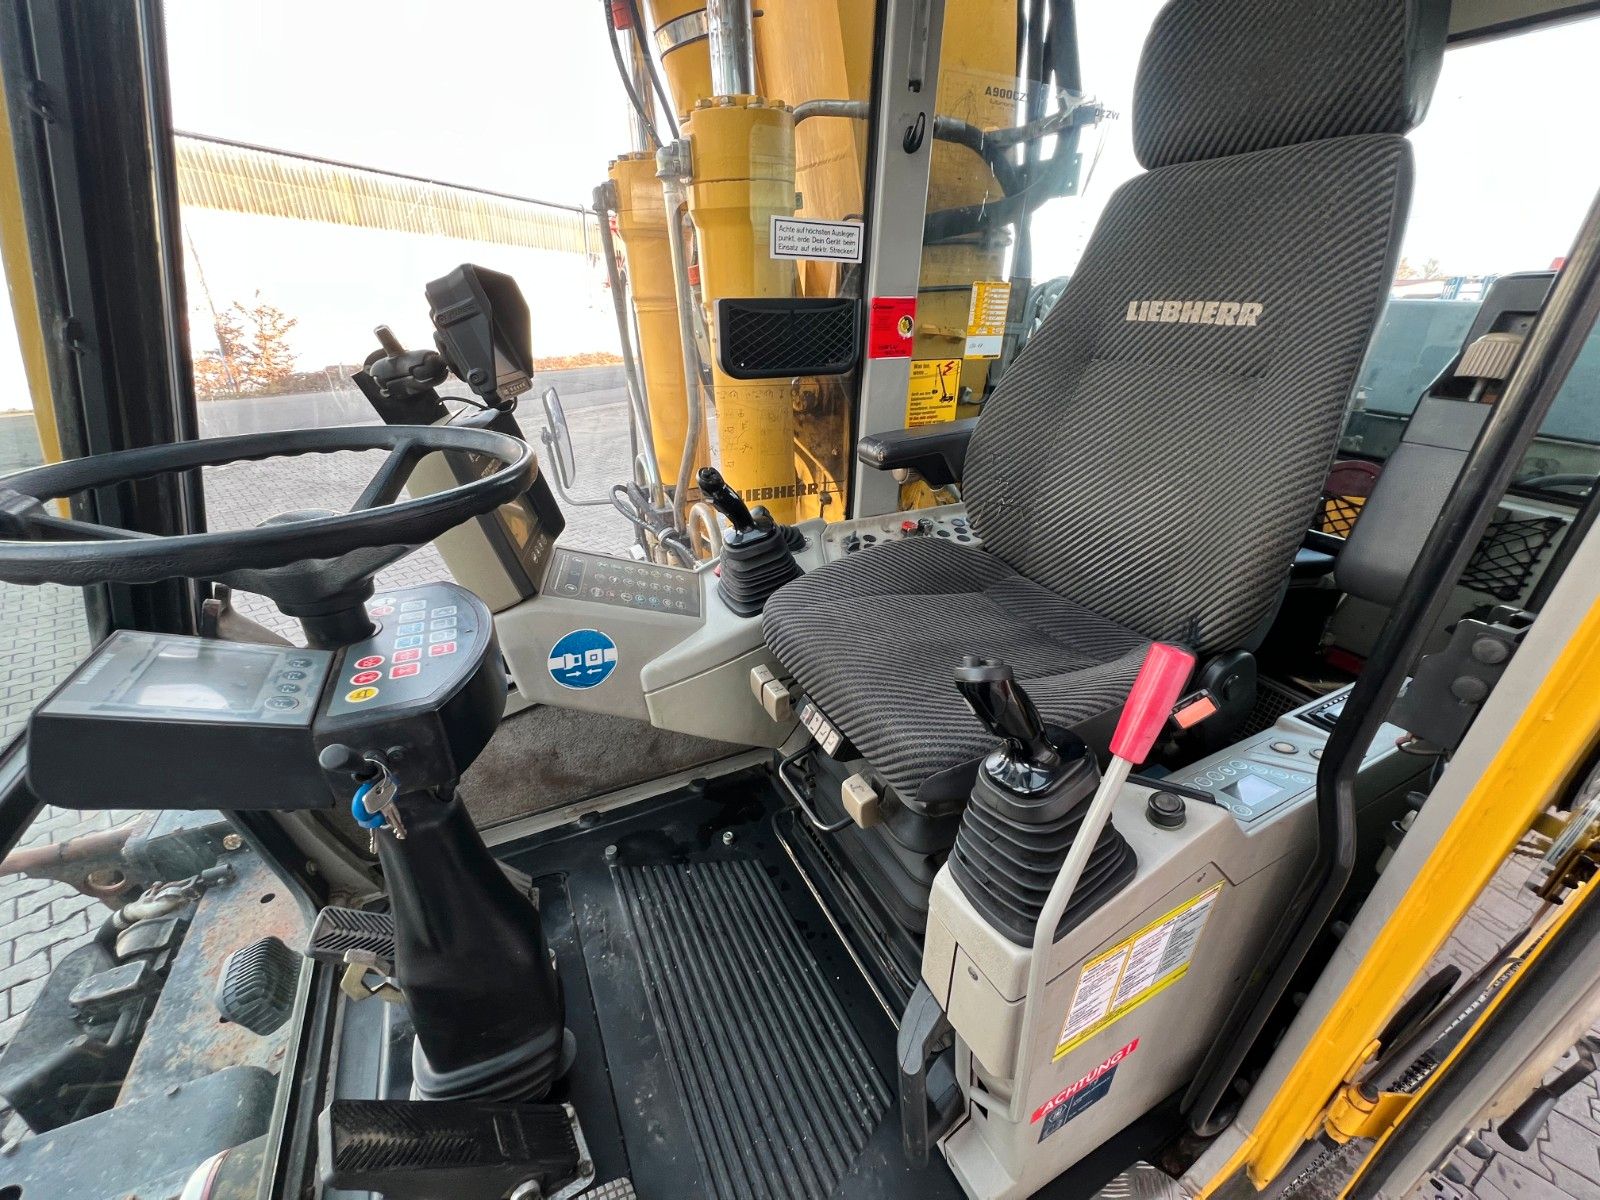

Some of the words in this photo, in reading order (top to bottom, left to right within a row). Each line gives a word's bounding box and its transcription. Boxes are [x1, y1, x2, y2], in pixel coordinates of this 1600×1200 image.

[778, 225, 796, 233] Achte
[811, 236, 825, 245] Dein
[778, 243, 798, 252] Einsatz
[829, 247, 856, 255] Strecken!
[1126, 300, 1264, 327] LIEBHERR
[1040, 1043, 1133, 1116] ACHTUNG!
